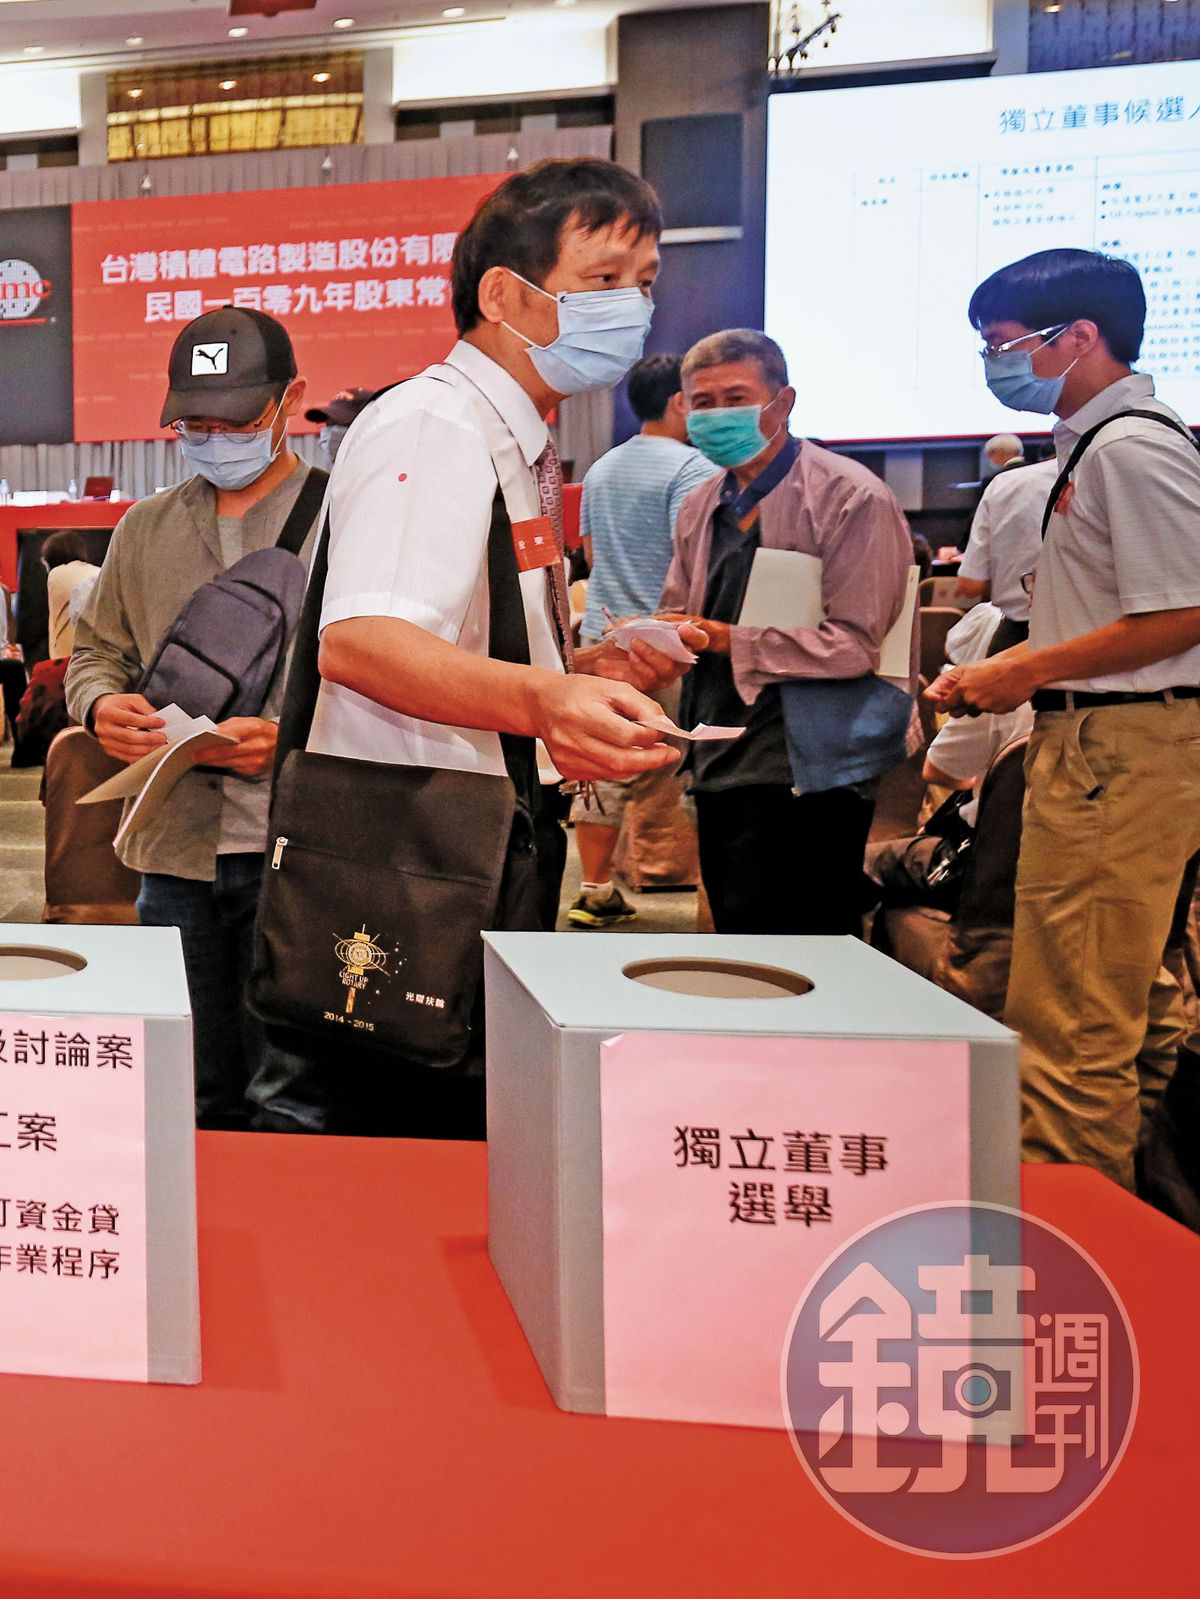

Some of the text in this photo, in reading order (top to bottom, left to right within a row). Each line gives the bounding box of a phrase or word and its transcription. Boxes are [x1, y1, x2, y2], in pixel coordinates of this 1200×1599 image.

[100, 232, 459, 285] 台灣積體電路製造股份有限
[144, 275, 453, 323] 民國一百零九年股東常
[673, 1125, 888, 1177] 獨立董事
[728, 1181, 833, 1228] 選舉
